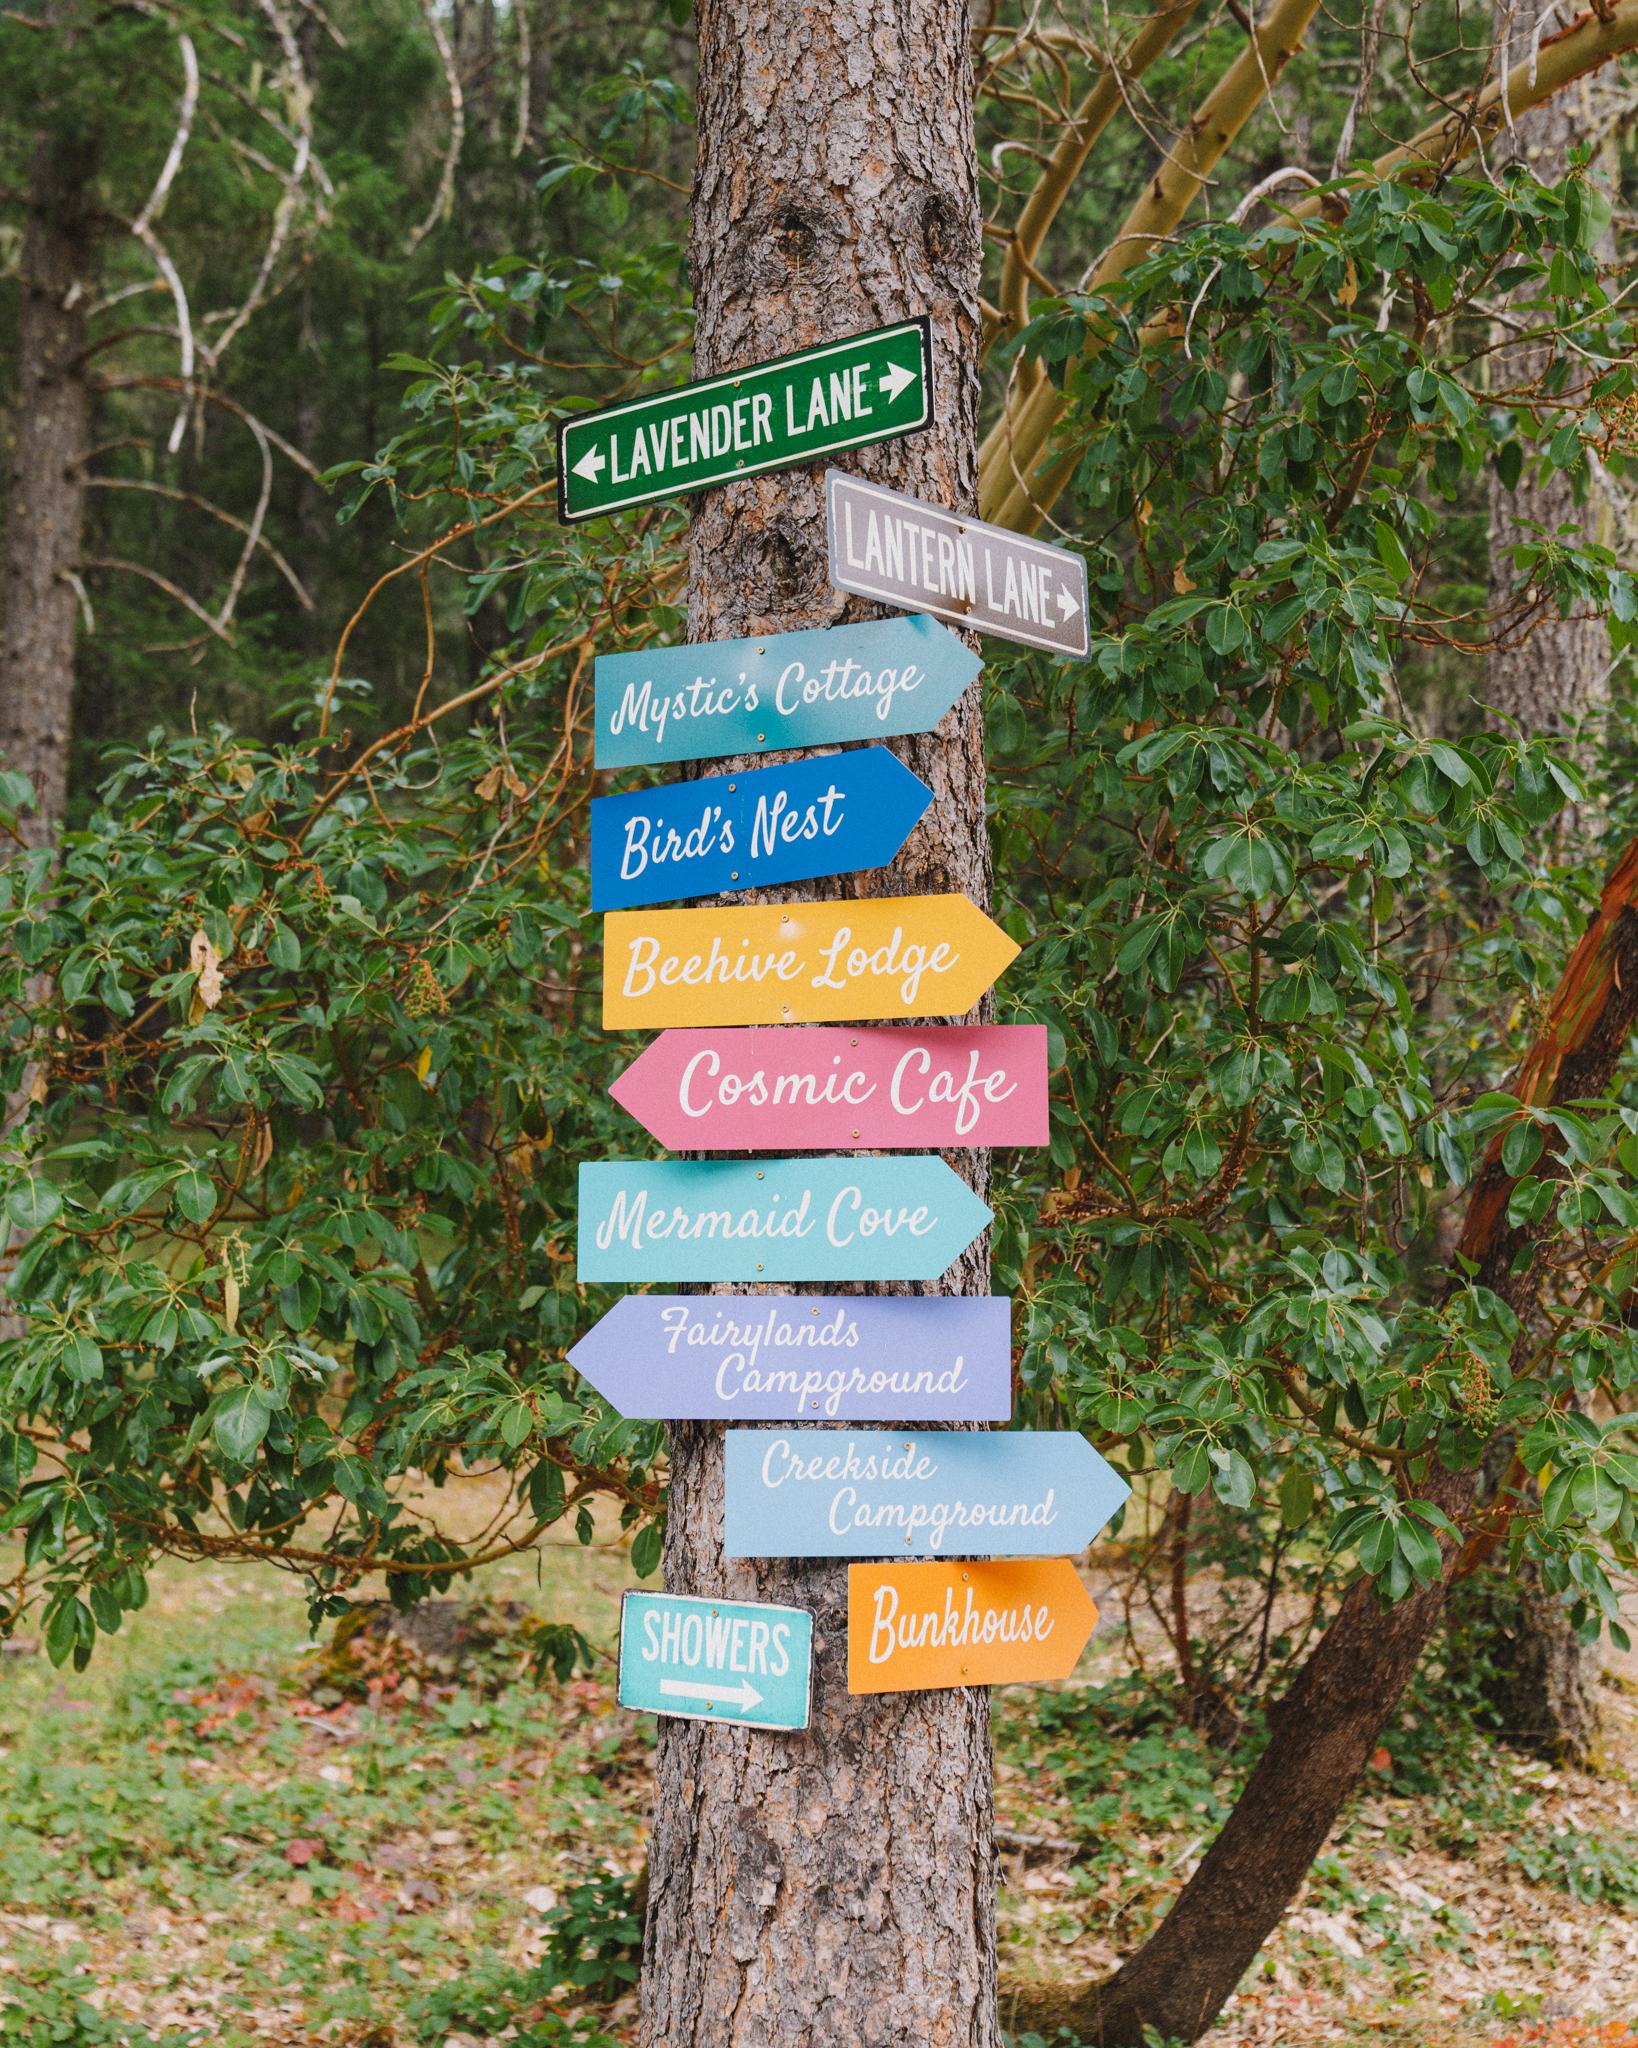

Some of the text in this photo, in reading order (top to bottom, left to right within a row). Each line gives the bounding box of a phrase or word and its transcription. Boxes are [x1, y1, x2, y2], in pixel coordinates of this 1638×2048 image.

[610, 363, 873, 484] LAVENDER LANE
[845, 501, 1056, 628] LANTERN LANE
[775, 658, 926, 720] Cottage
[751, 785, 846, 858] Nest
[622, 926, 960, 1004] Beehive Lodge
[679, 1048, 1017, 1135] Cosmic Cafe
[596, 1186, 939, 1249] Mermaid Cove
[661, 1306, 860, 1365] Fairylands
[715, 1353, 969, 1416] Campground
[761, 1439, 938, 1489] Creekside
[828, 1486, 1059, 1550] Campground
[641, 1609, 790, 1677] SHOWERS
[869, 1584, 1055, 1664] Bunkhouse
